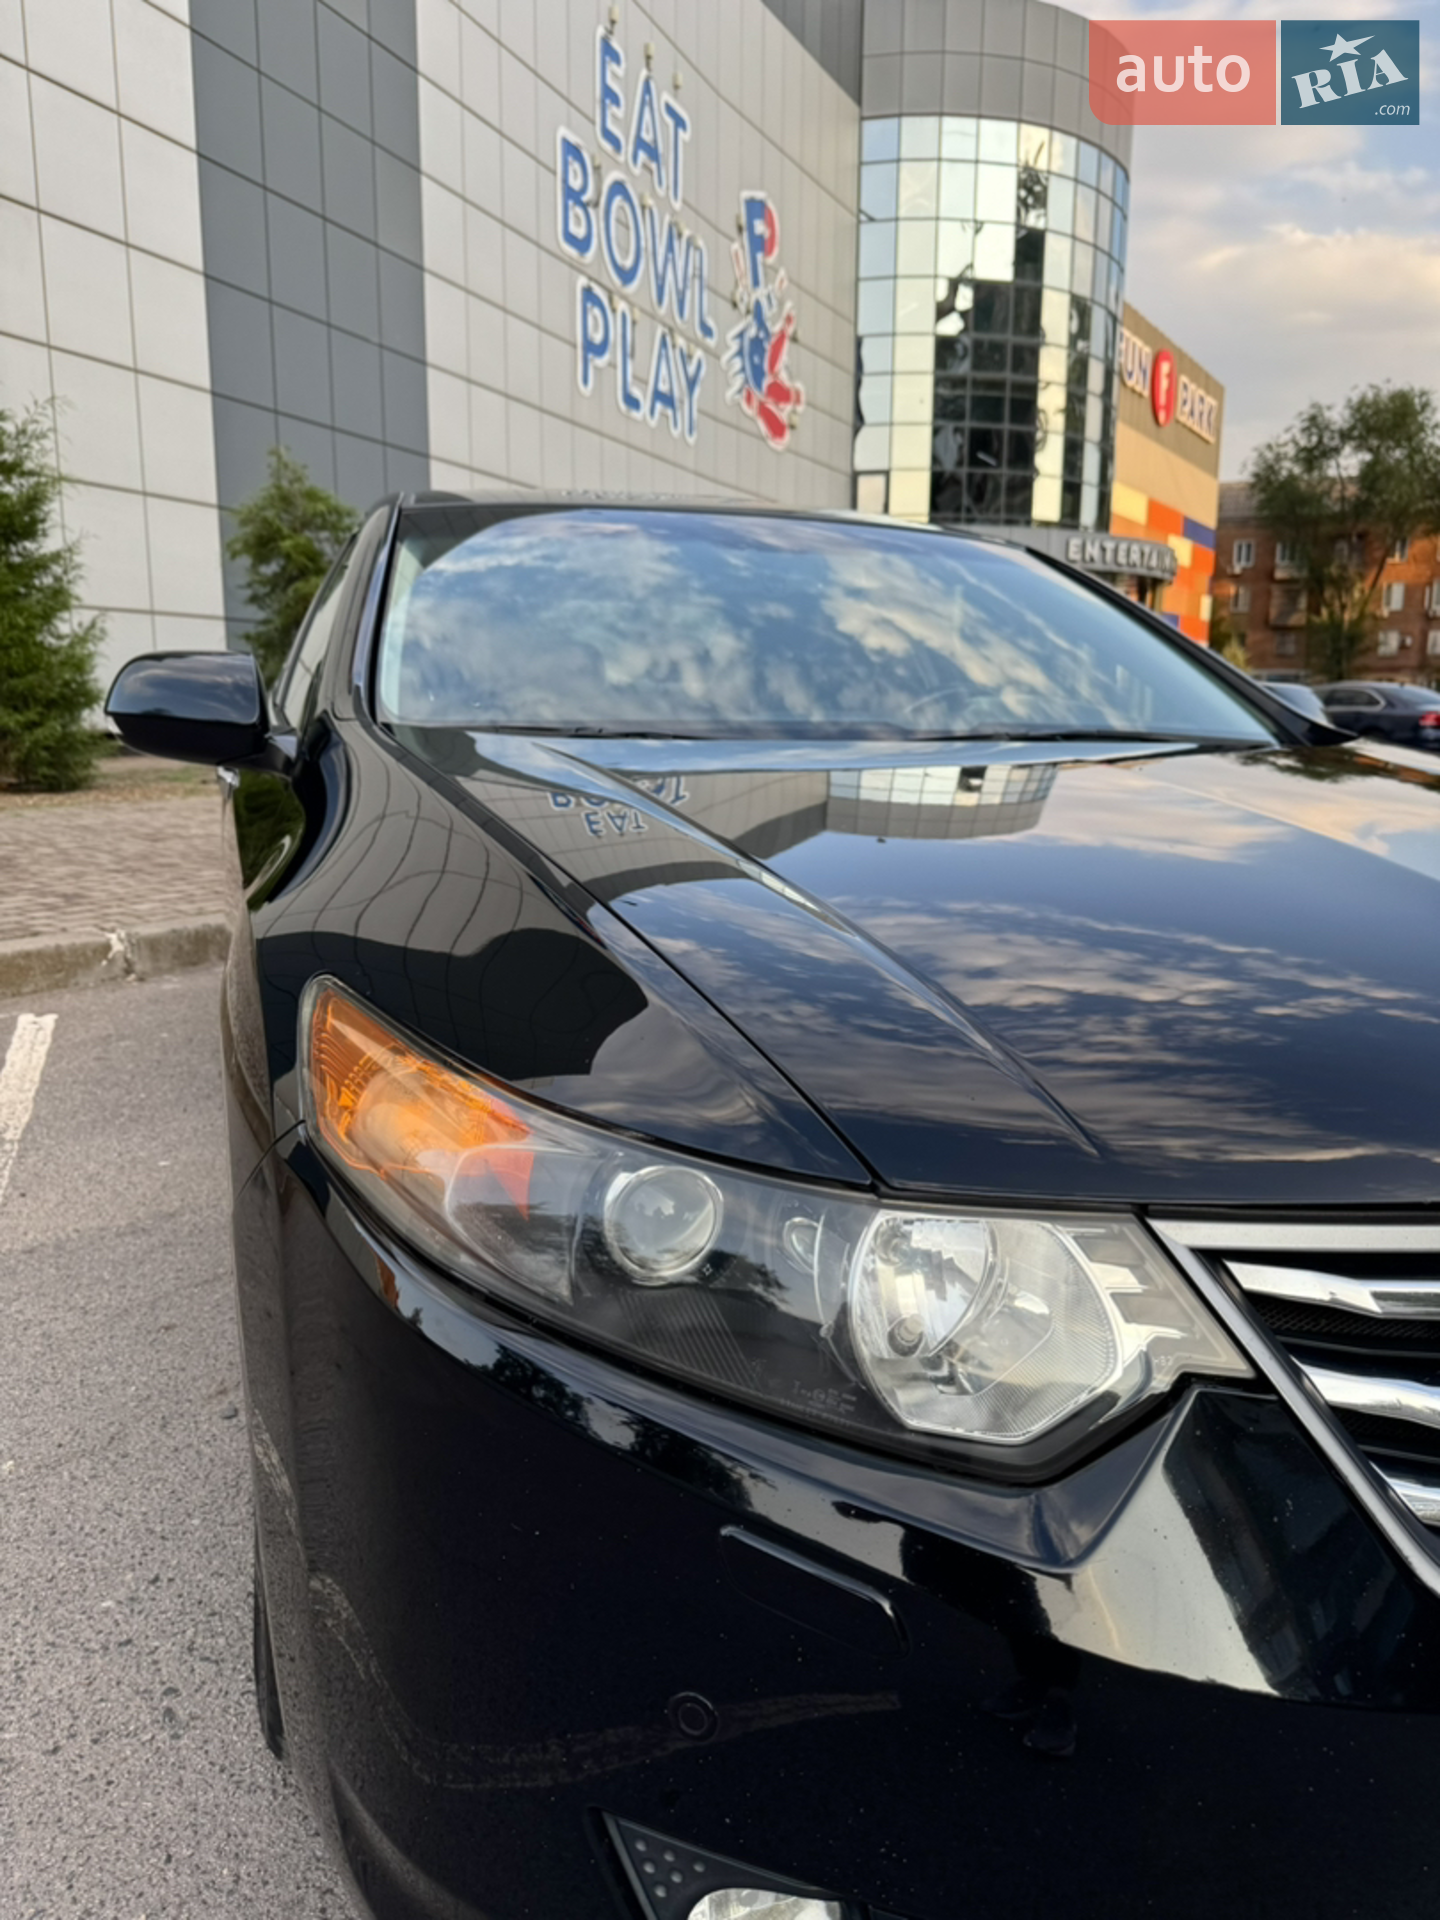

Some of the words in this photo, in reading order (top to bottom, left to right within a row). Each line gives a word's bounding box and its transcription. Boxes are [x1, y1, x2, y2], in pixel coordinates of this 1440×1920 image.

[597, 28, 691, 208] EAT
[558, 127, 716, 342] BOWL
[579, 277, 704, 443] PLAY
[1176, 374, 1218, 444] PARK
